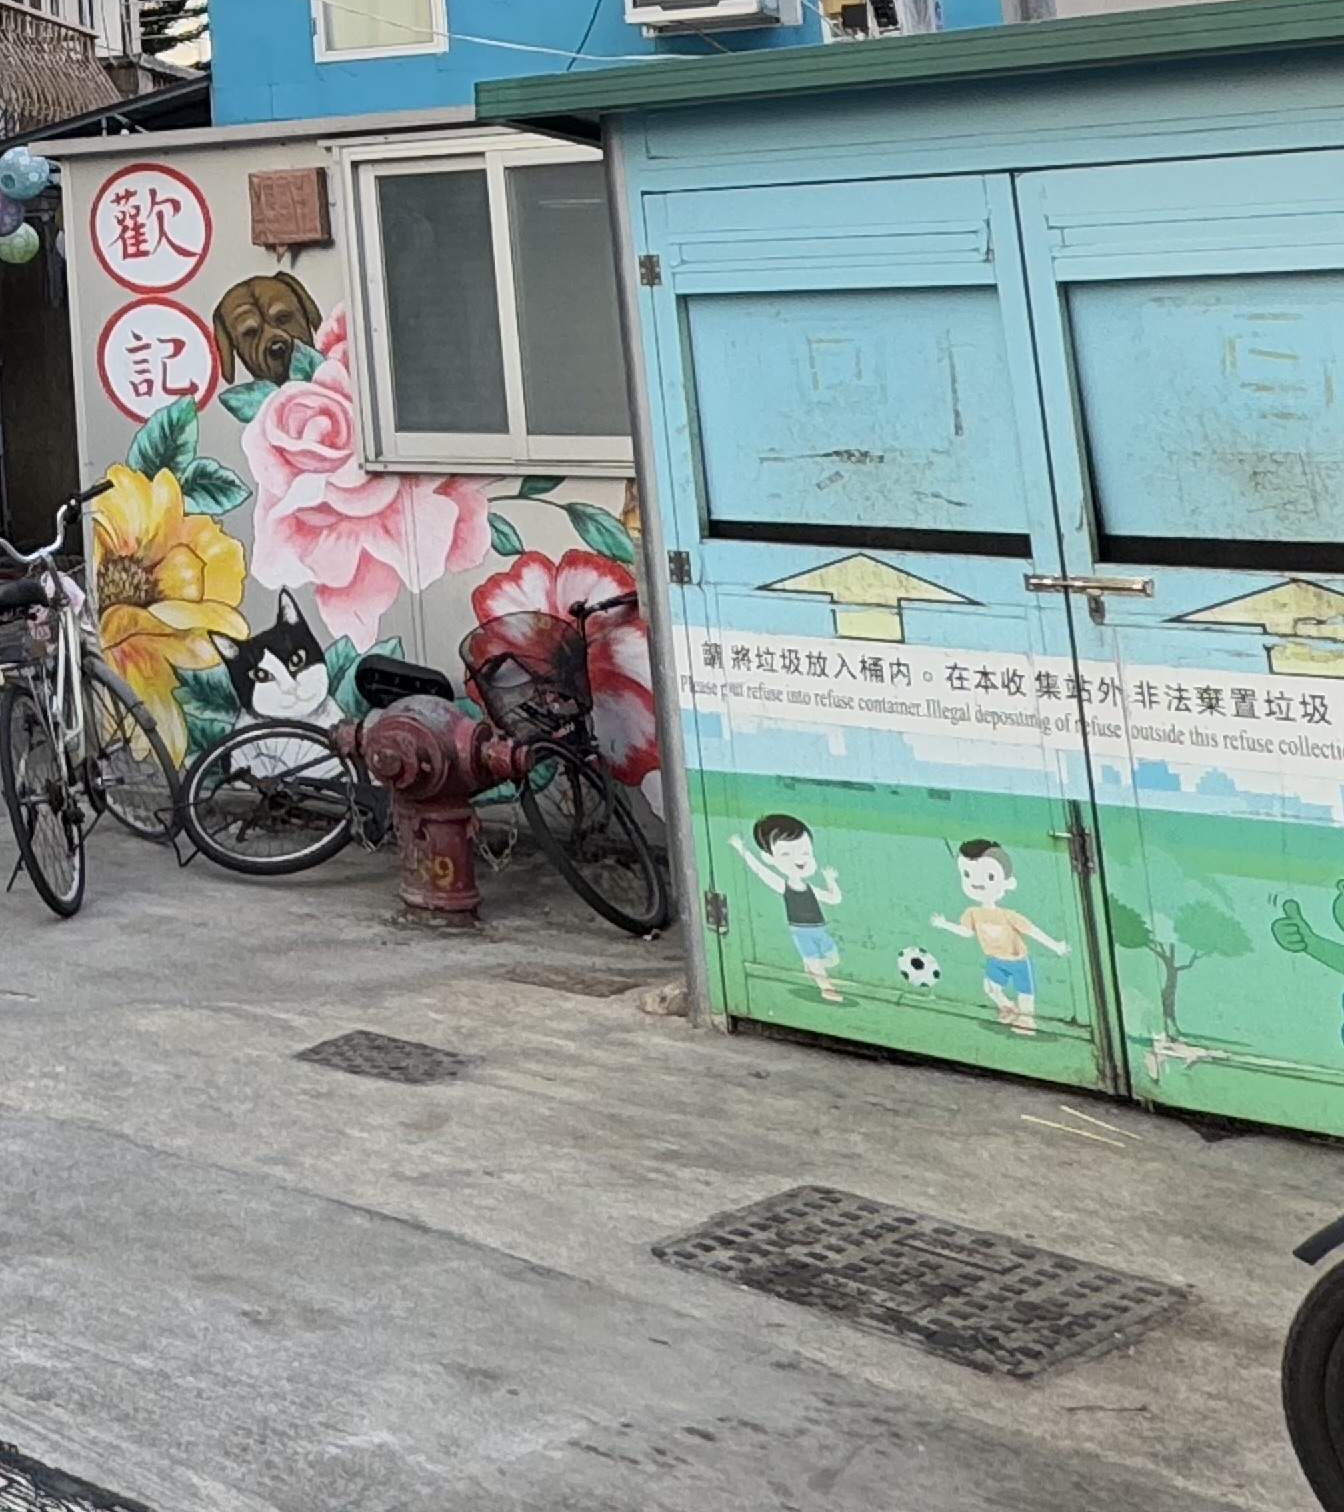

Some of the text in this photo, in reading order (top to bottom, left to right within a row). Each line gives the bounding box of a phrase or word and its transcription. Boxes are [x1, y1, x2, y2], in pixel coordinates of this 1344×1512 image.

[108, 187, 202, 399] 歡記
[746, 681, 783, 702] refuse
[814, 688, 855, 711] refuse
[1055, 713, 1072, 734] of
[1131, 722, 1186, 746] outside
[1189, 726, 1219, 749] this
[1222, 729, 1275, 755] refuse
[1278, 735, 1344, 761] collecti
